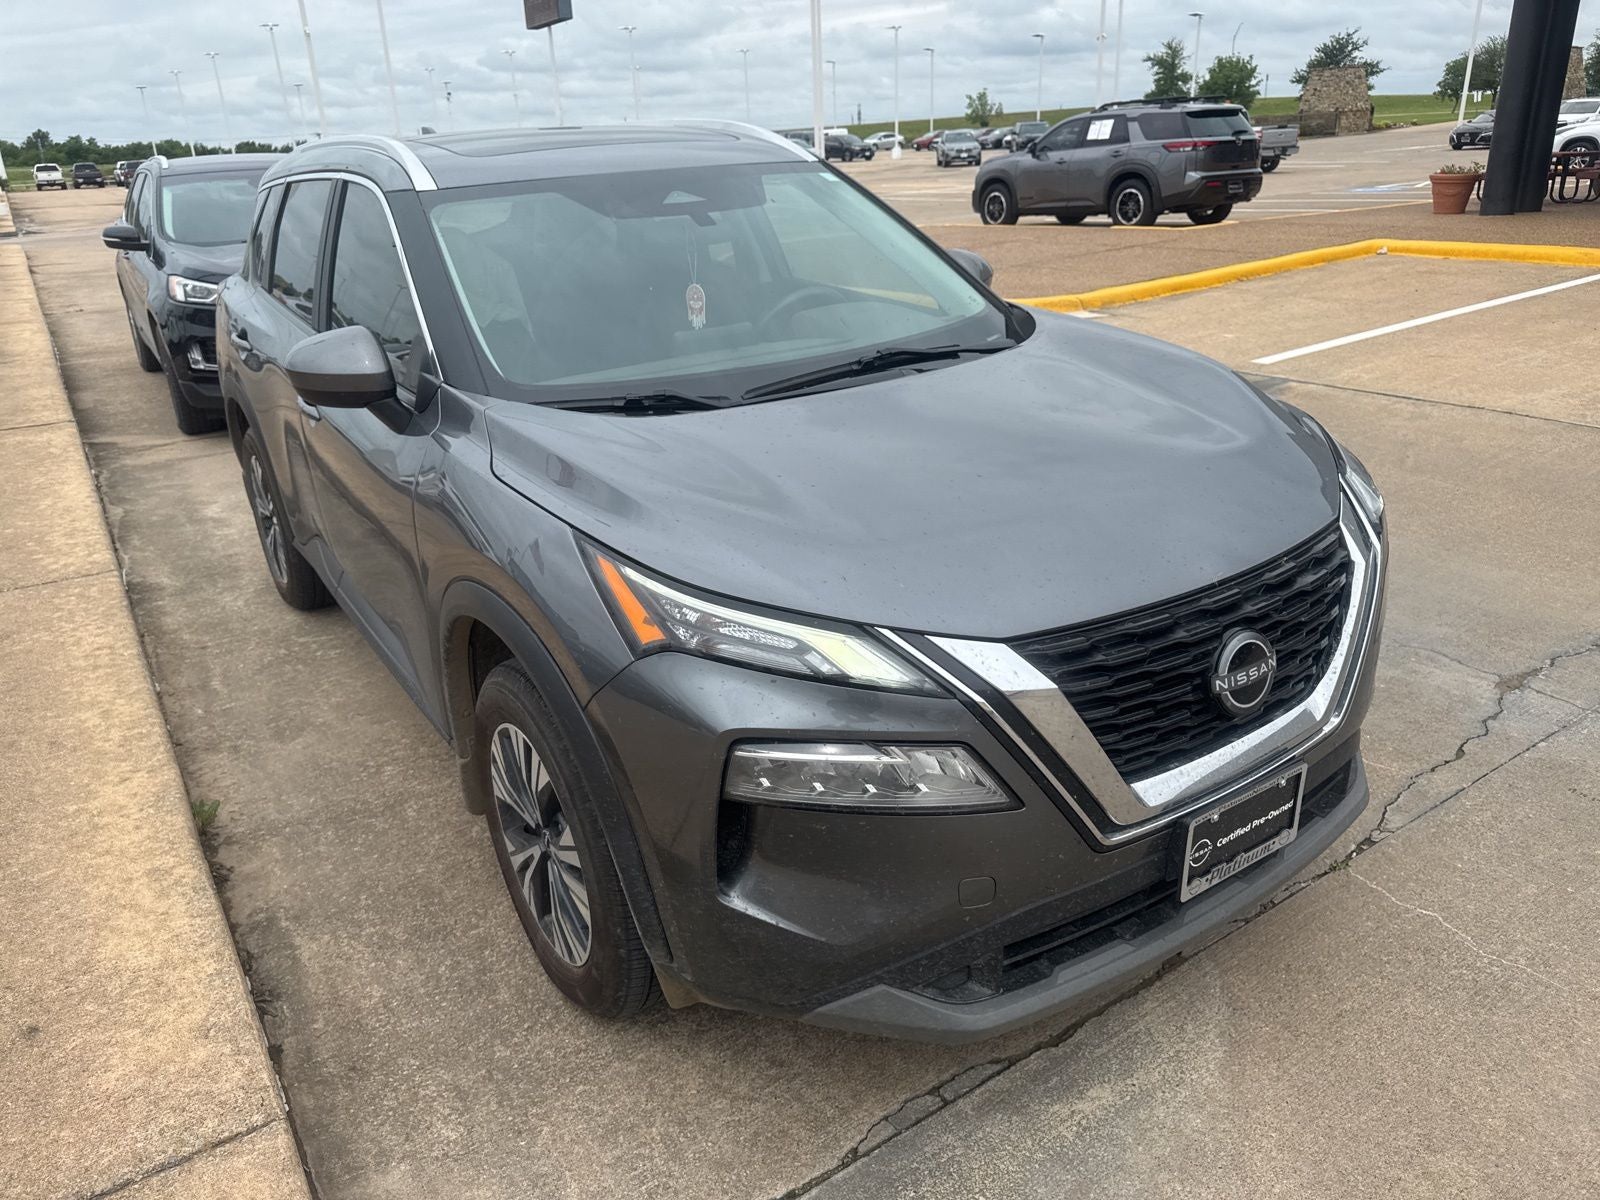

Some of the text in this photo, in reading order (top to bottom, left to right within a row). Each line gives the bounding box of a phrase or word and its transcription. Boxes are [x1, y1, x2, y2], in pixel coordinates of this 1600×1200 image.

[1216, 658, 1276, 691] NISSAN
[1217, 799, 1294, 847] Certified Pre-Owned
[1189, 844, 1213, 860] NISSAN
[1209, 843, 1272, 884] Platinum
